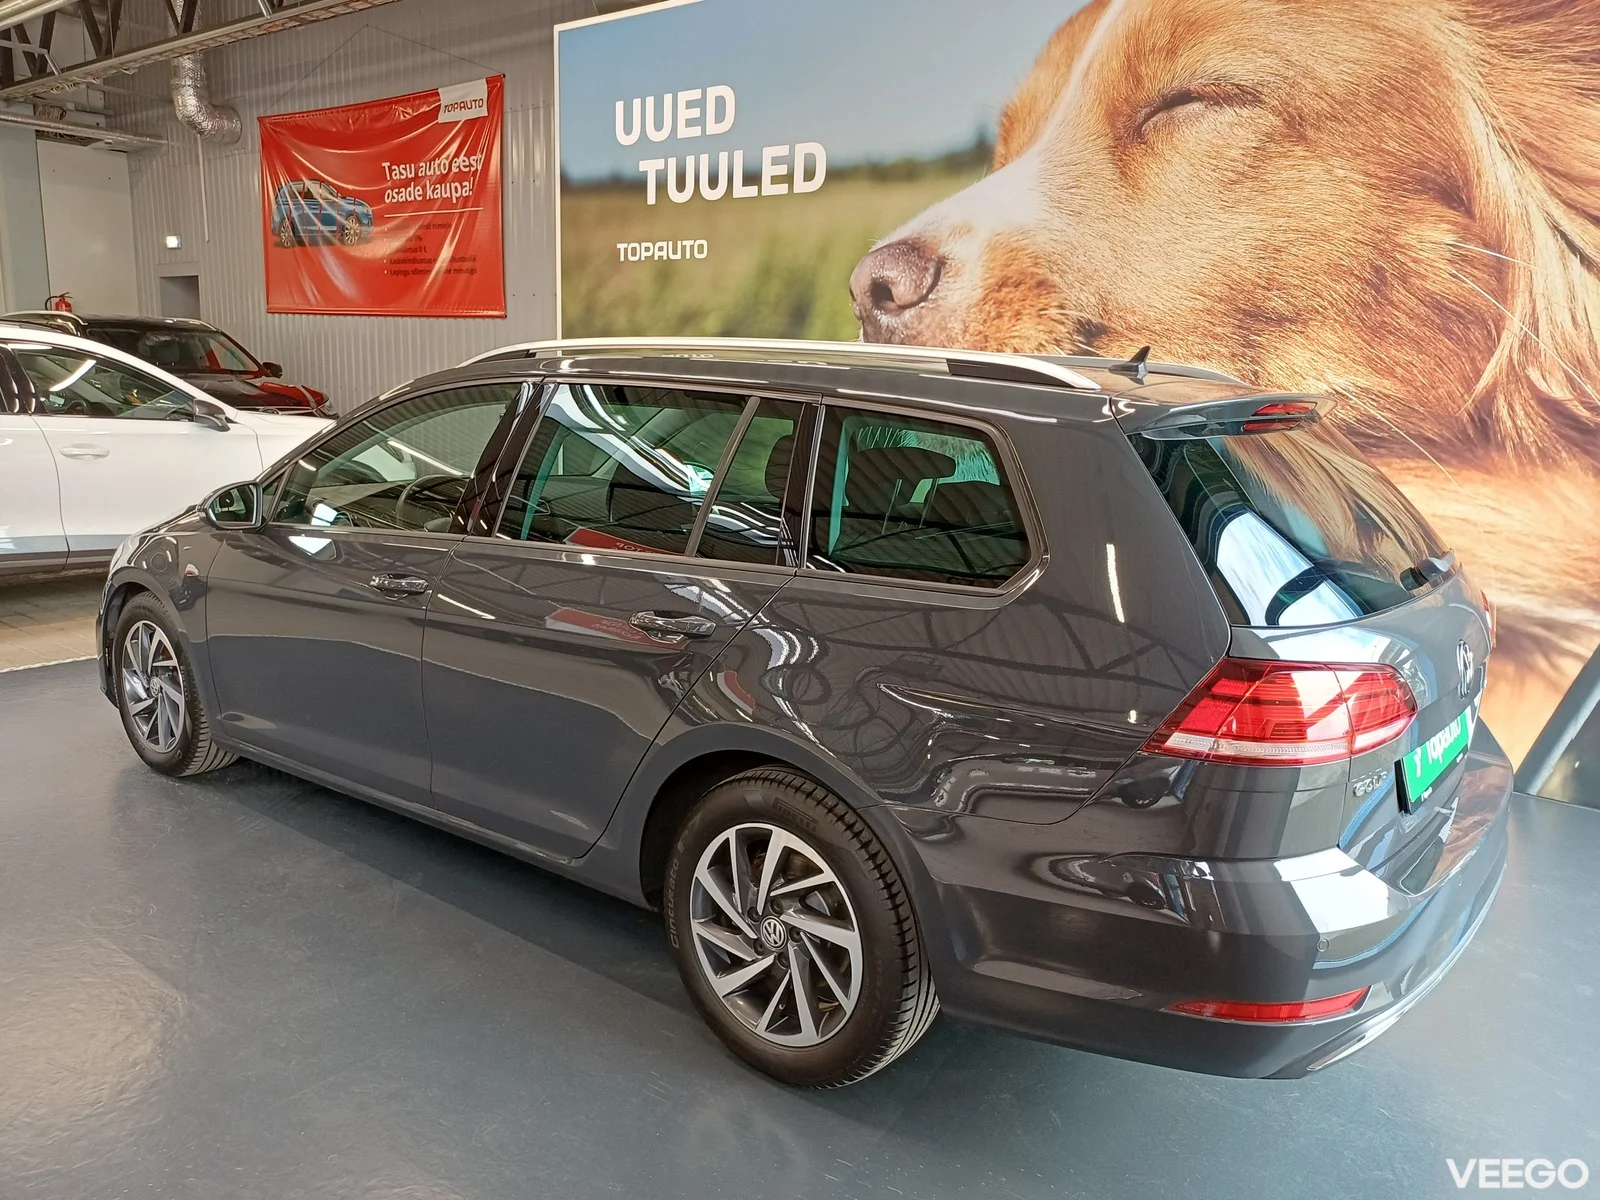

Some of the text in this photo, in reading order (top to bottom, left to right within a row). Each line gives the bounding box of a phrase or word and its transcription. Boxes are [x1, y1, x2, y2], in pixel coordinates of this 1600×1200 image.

[443, 98, 484, 114] TOPAUTO
[615, 84, 736, 146] UUED
[381, 154, 483, 180] Tasu auto eest
[638, 141, 827, 206] TUULED
[384, 176, 474, 204] osade kaupa!
[616, 239, 708, 262] TOPAUTO
